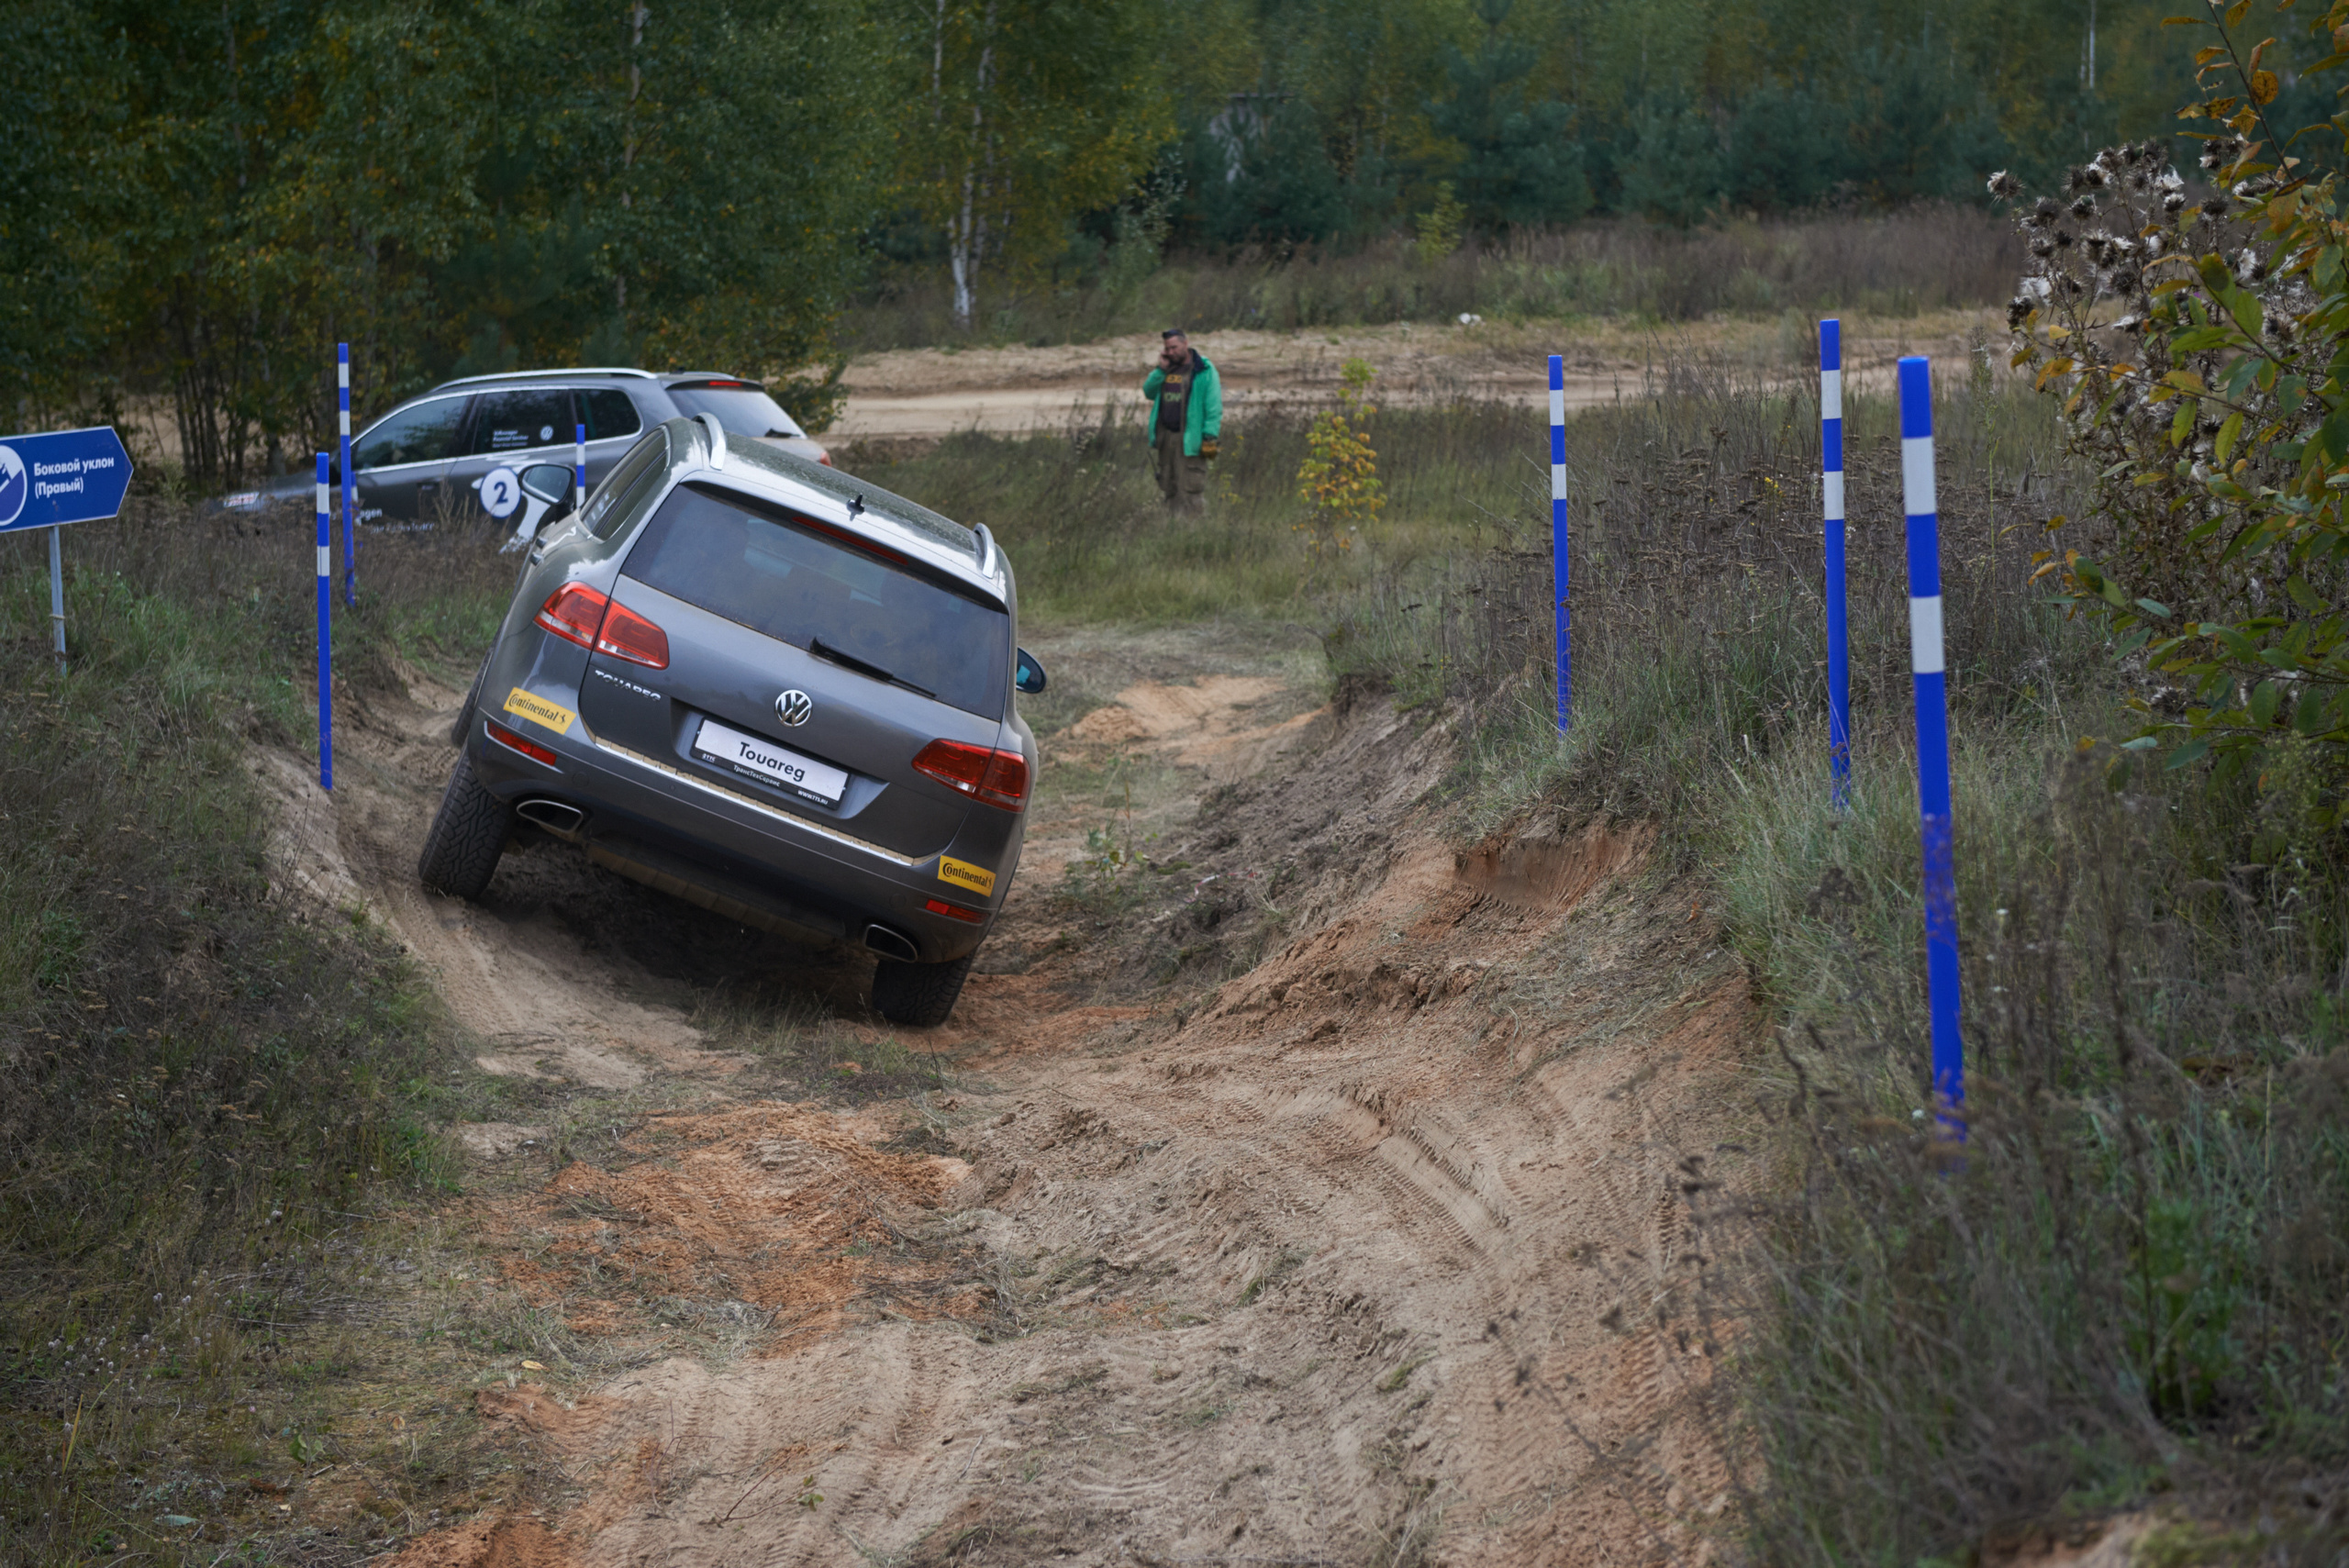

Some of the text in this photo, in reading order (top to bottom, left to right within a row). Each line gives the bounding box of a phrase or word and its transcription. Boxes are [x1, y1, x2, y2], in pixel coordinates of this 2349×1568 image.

[34, 457, 115, 476] Боковой уклон
[35, 476, 83, 499] (Правый)
[494, 481, 508, 504] 2
[508, 693, 560, 722] Continental
[739, 741, 806, 783] Touareg
[733, 764, 781, 787] ТрансТехСервис
[942, 862, 988, 888] Continental
